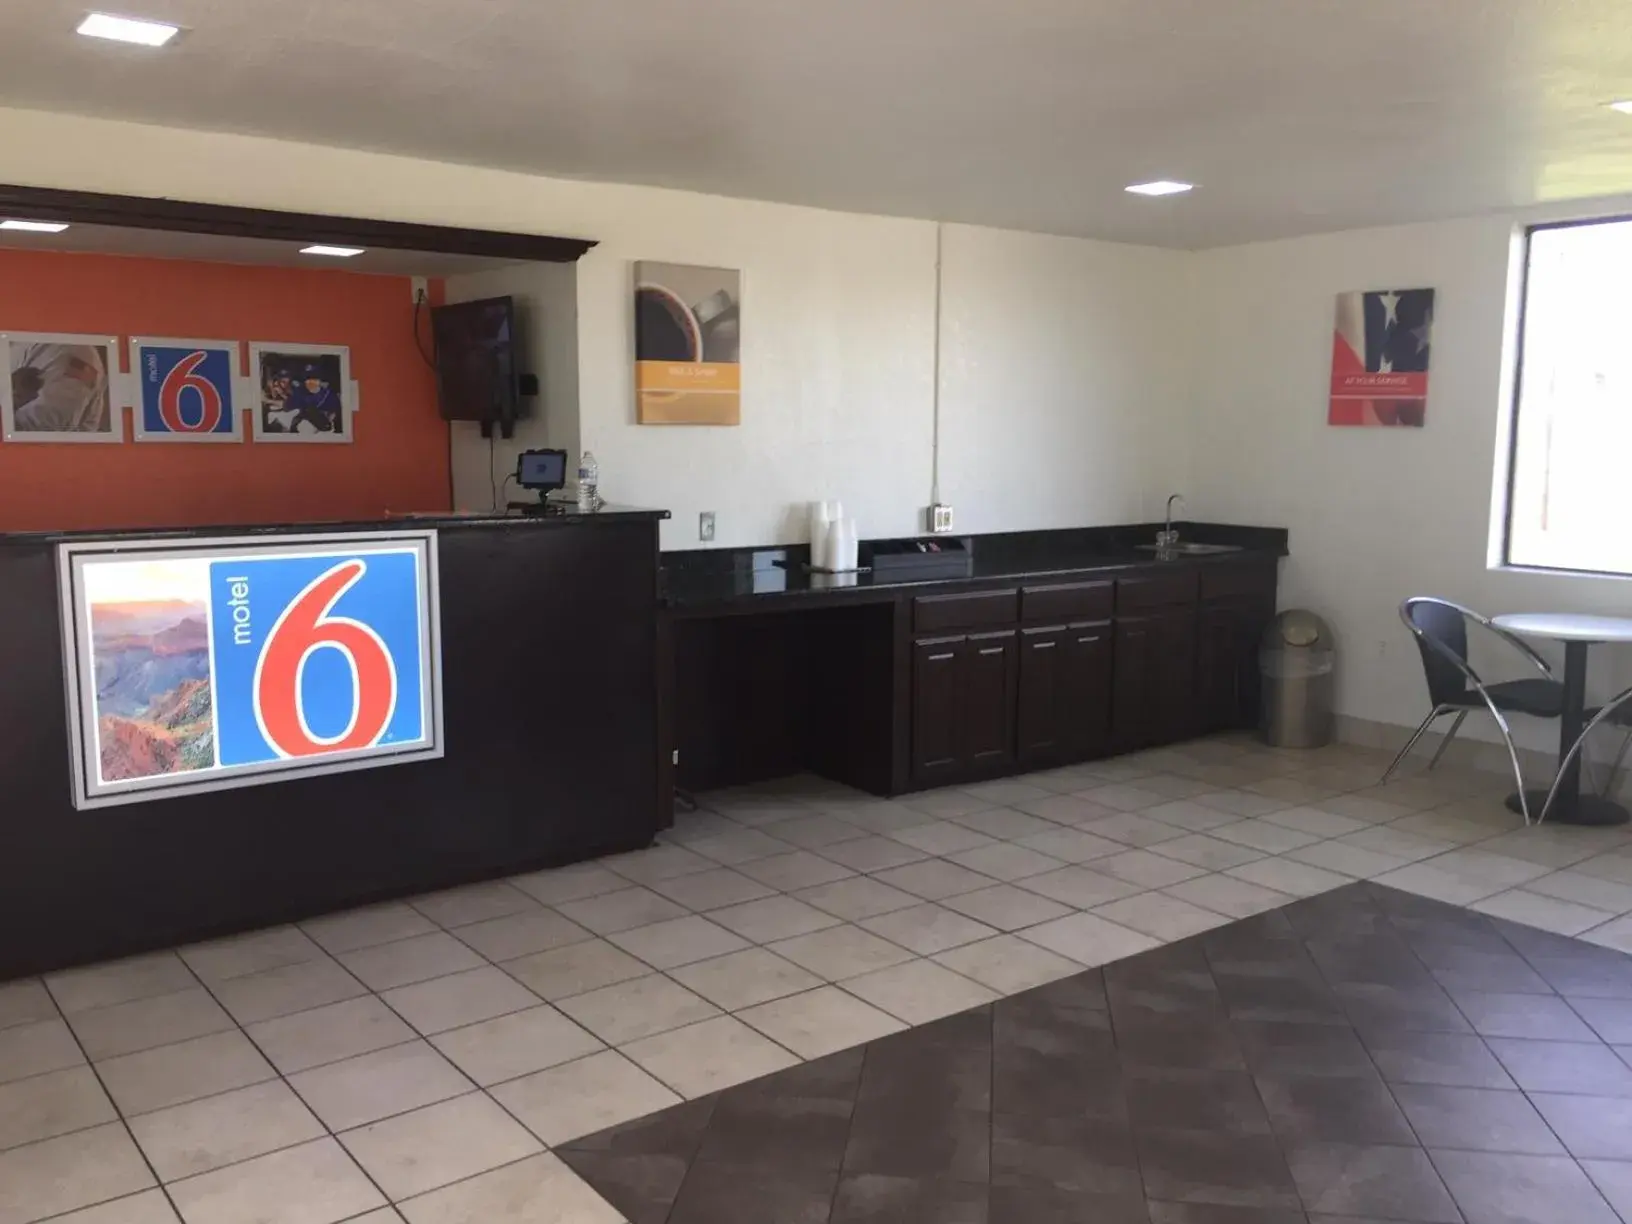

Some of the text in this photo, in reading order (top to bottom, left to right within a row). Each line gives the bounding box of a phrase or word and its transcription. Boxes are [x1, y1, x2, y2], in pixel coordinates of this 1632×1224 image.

[146, 350, 222, 434] motel 6
[226, 558, 398, 759] motel 6
